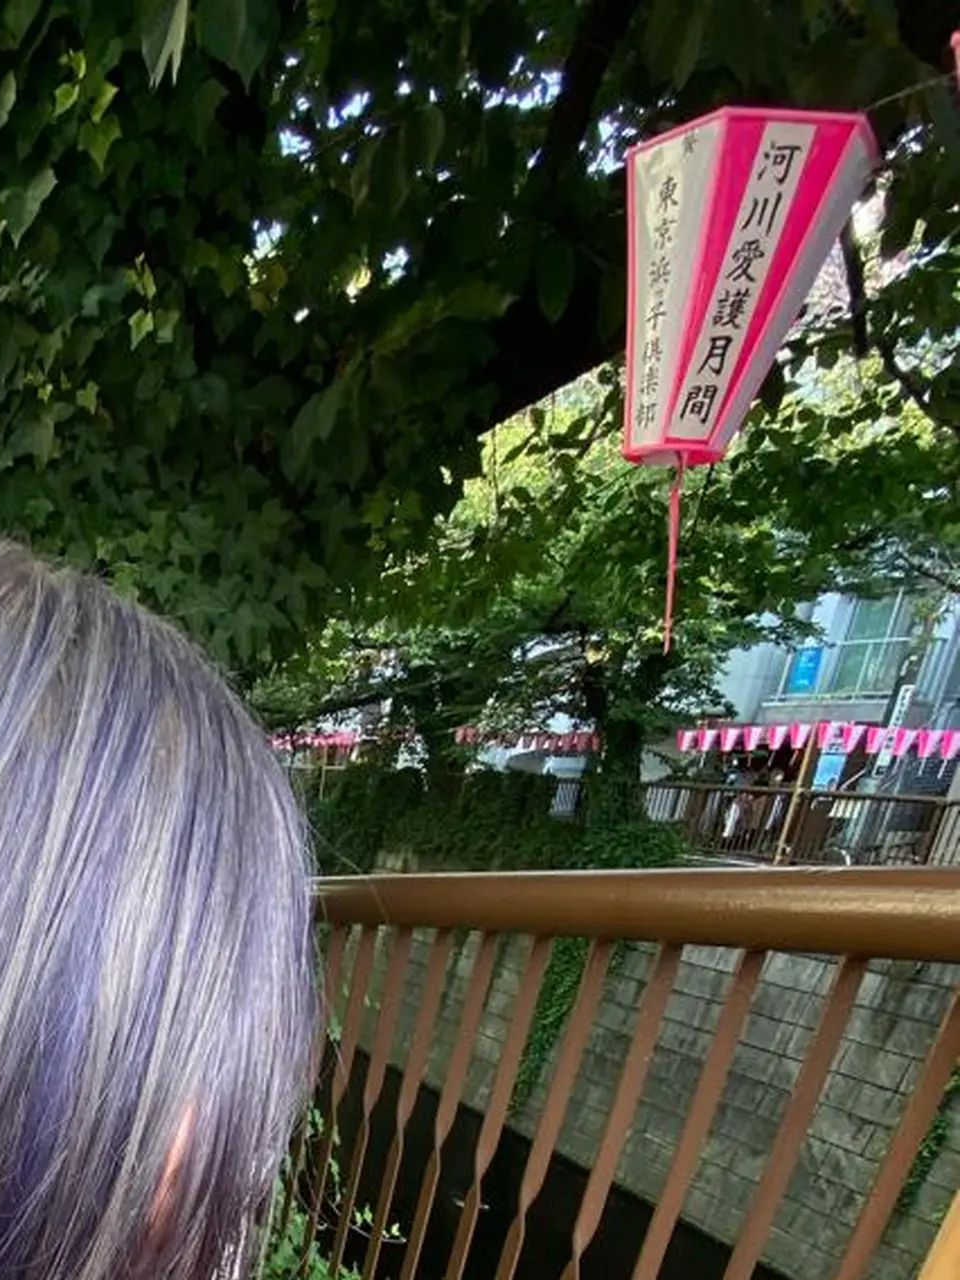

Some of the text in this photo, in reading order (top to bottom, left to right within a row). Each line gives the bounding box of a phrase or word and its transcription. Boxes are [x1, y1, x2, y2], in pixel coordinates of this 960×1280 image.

[679, 141, 803, 424] 河川愛護月間
